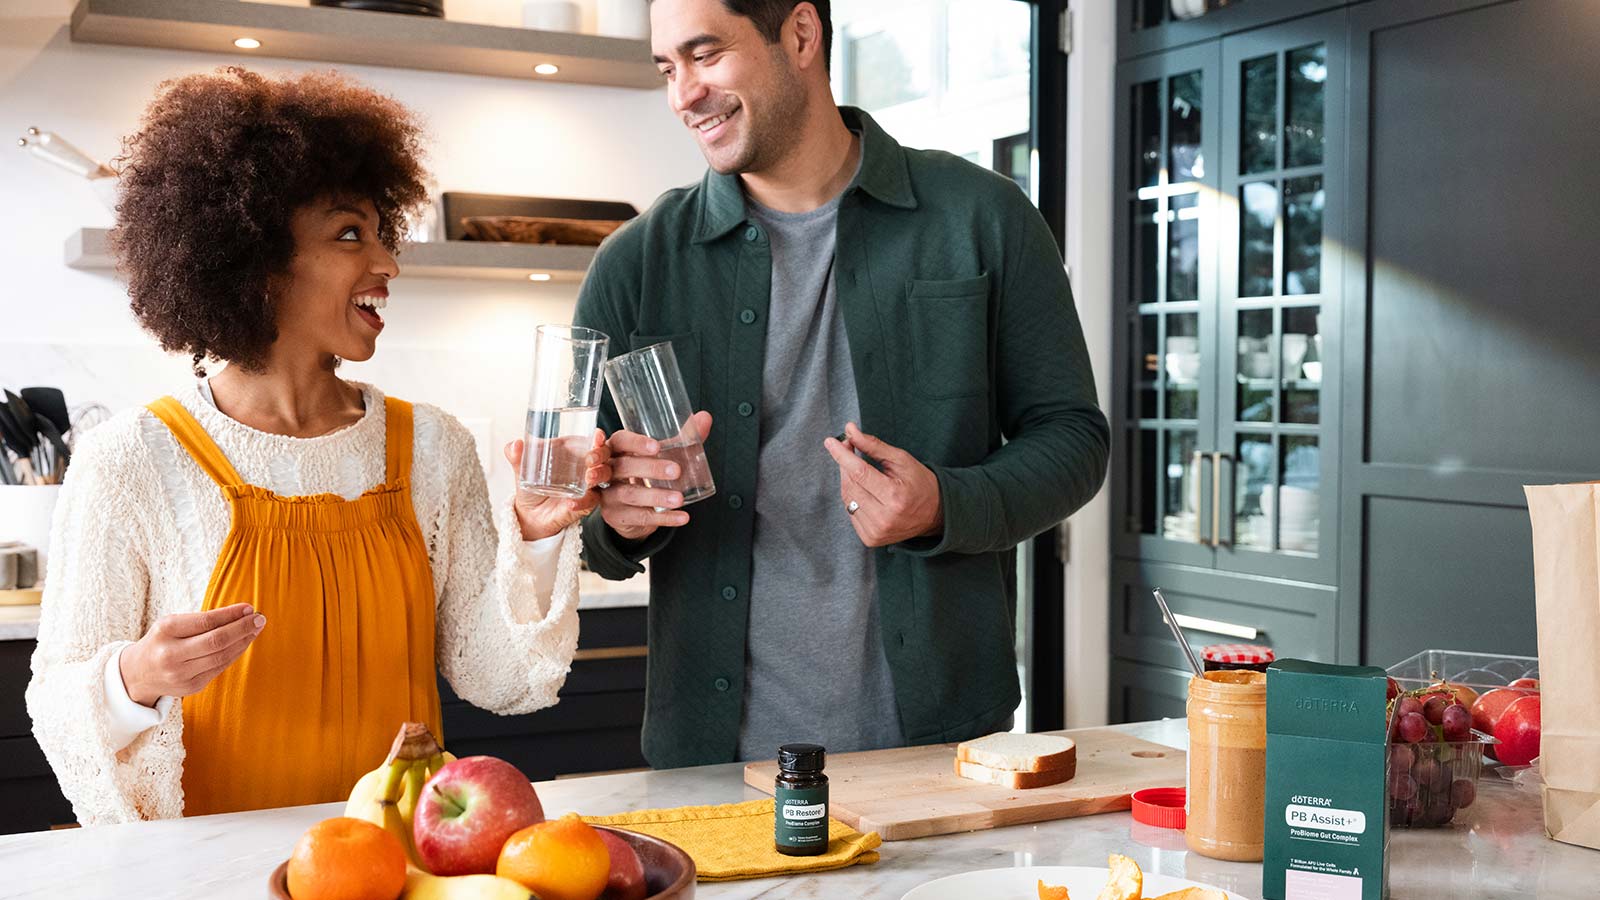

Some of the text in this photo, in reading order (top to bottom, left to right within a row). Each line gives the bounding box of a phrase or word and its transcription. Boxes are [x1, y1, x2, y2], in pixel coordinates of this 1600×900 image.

[1291, 811, 1307, 821] PB
[1290, 828, 1319, 838] ProBiome
[1332, 833, 1358, 842] Complex
